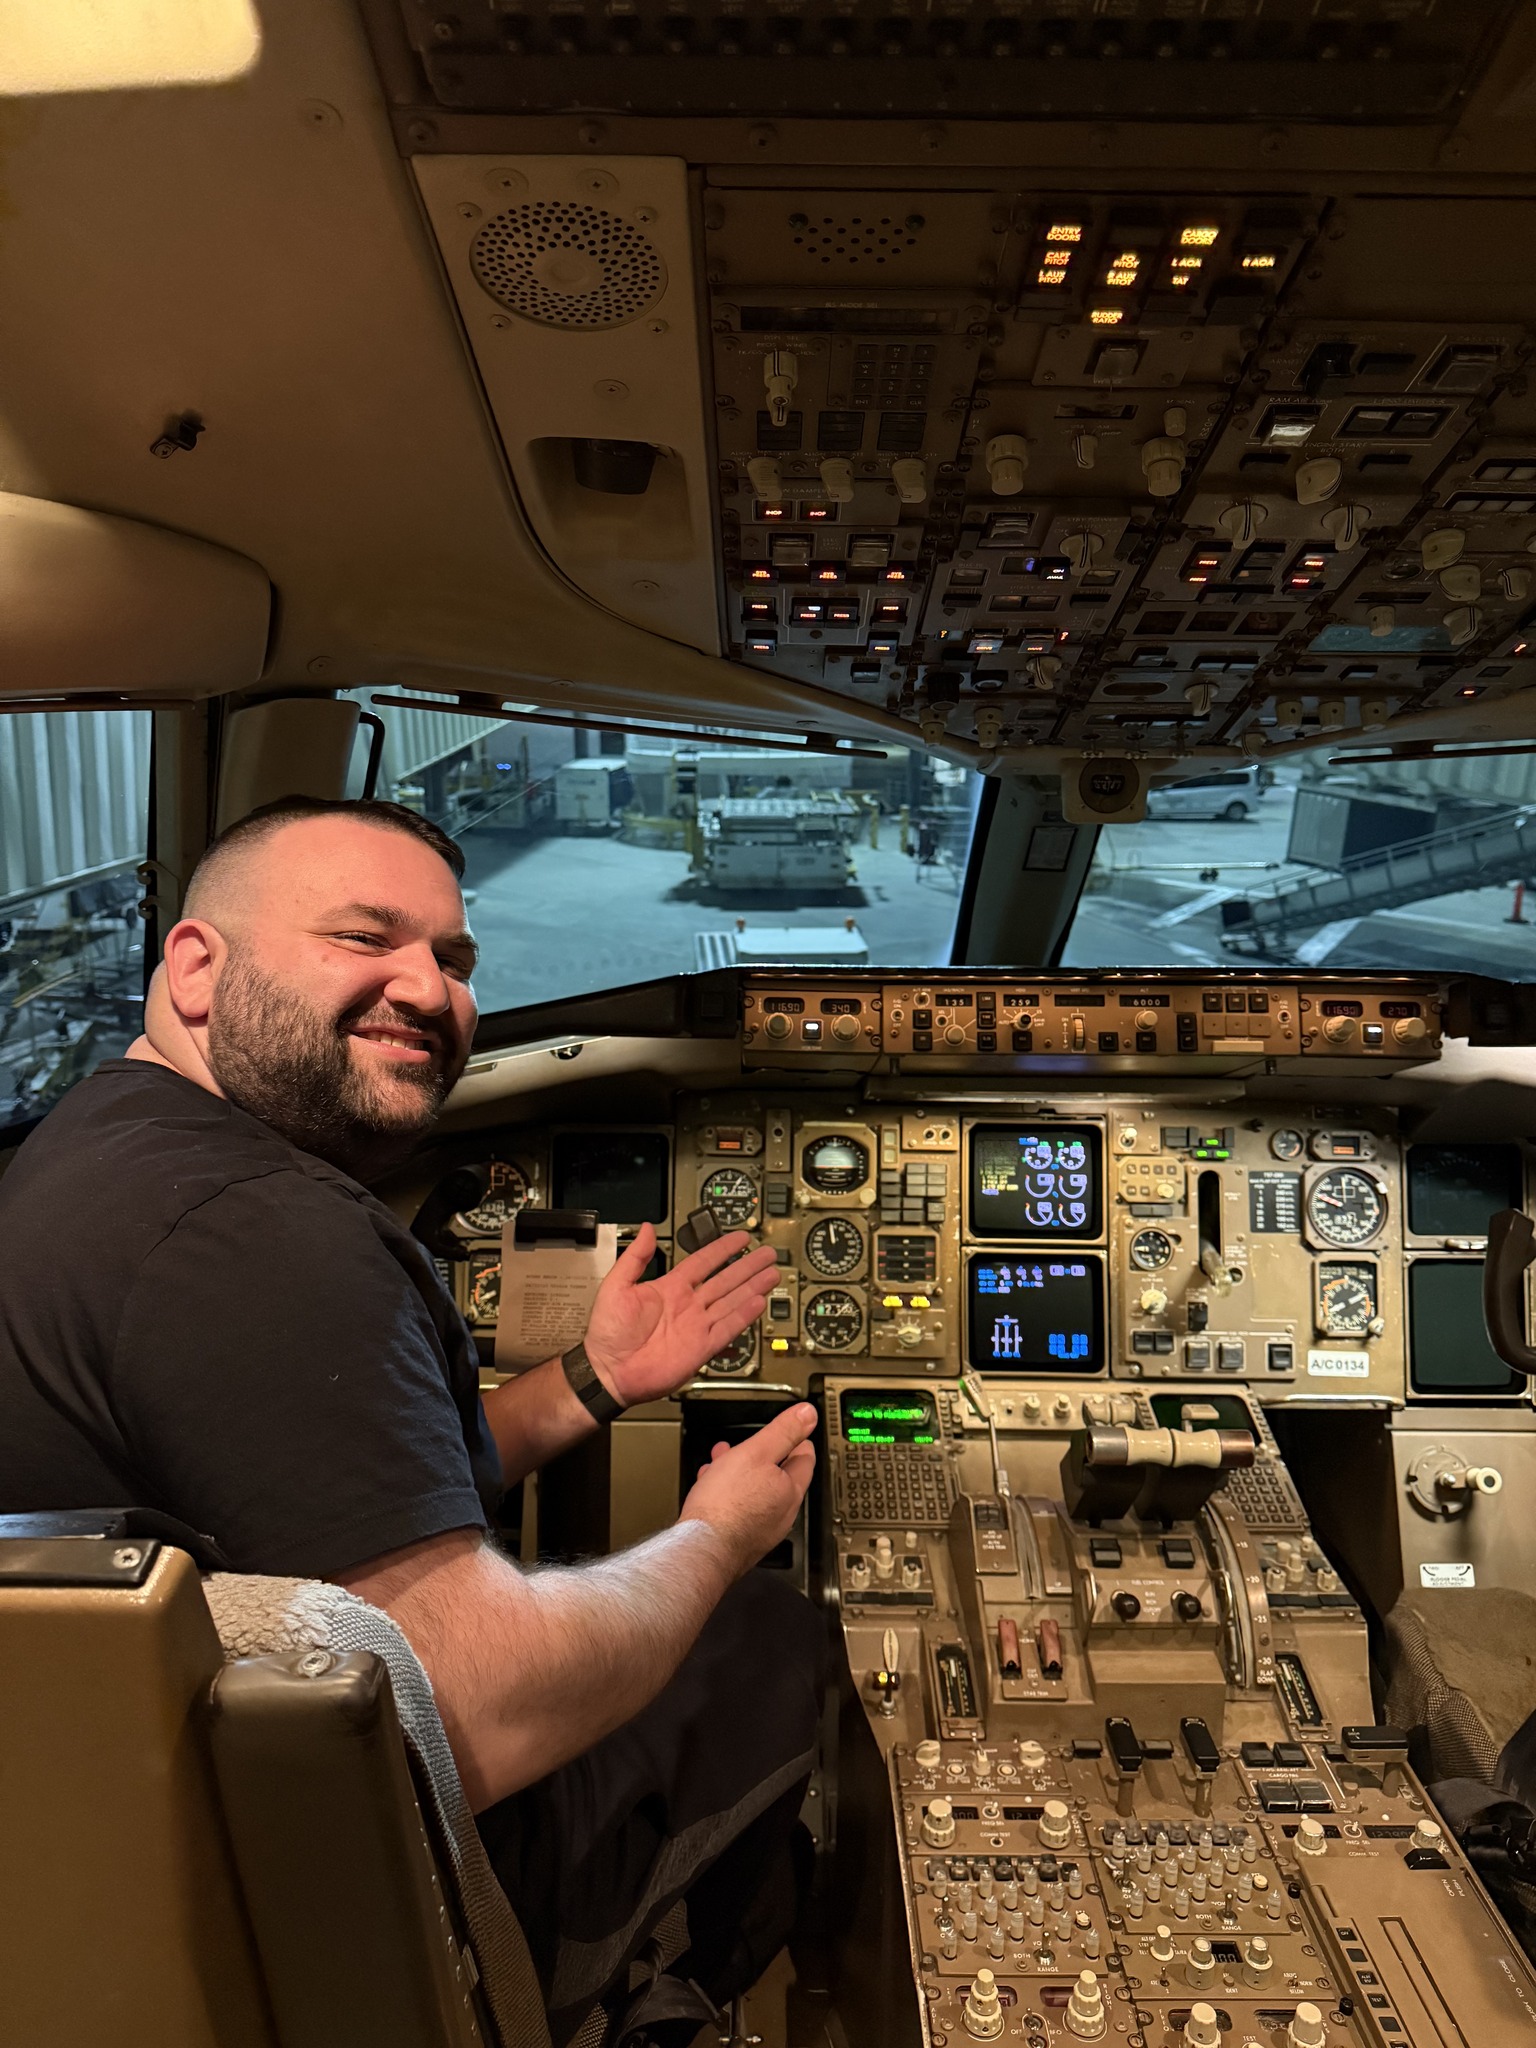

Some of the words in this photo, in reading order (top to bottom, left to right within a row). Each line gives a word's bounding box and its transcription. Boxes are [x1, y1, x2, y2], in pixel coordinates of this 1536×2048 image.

[1050, 225, 1081, 234] ENTRY
[1182, 228, 1219, 238] CARGO
[1046, 233, 1081, 241] DOORS
[1180, 237, 1213, 245] DOORS
[1046, 251, 1071, 259] CAPT
[1113, 260, 1140, 268] PITOT
[1171, 258, 1178, 267] L
[1178, 258, 1202, 267] AOA
[1242, 257, 1250, 267] R
[1250, 257, 1275, 267] AOA
[1107, 270, 1115, 279] R
[1116, 272, 1137, 280] AUX
[1172, 276, 1190, 285] TAT
[1091, 311, 1123, 319] RUDDER
[832, 1004, 850, 1013] 340
[1442, 1878, 1455, 1897] OPEN
[1452, 1879, 1465, 1897] PUSH
[1499, 1959, 1516, 1983] CLOSE
[1102, 1983, 1113, 2011] RIGHT
[1515, 1987, 1524, 1998] TO
